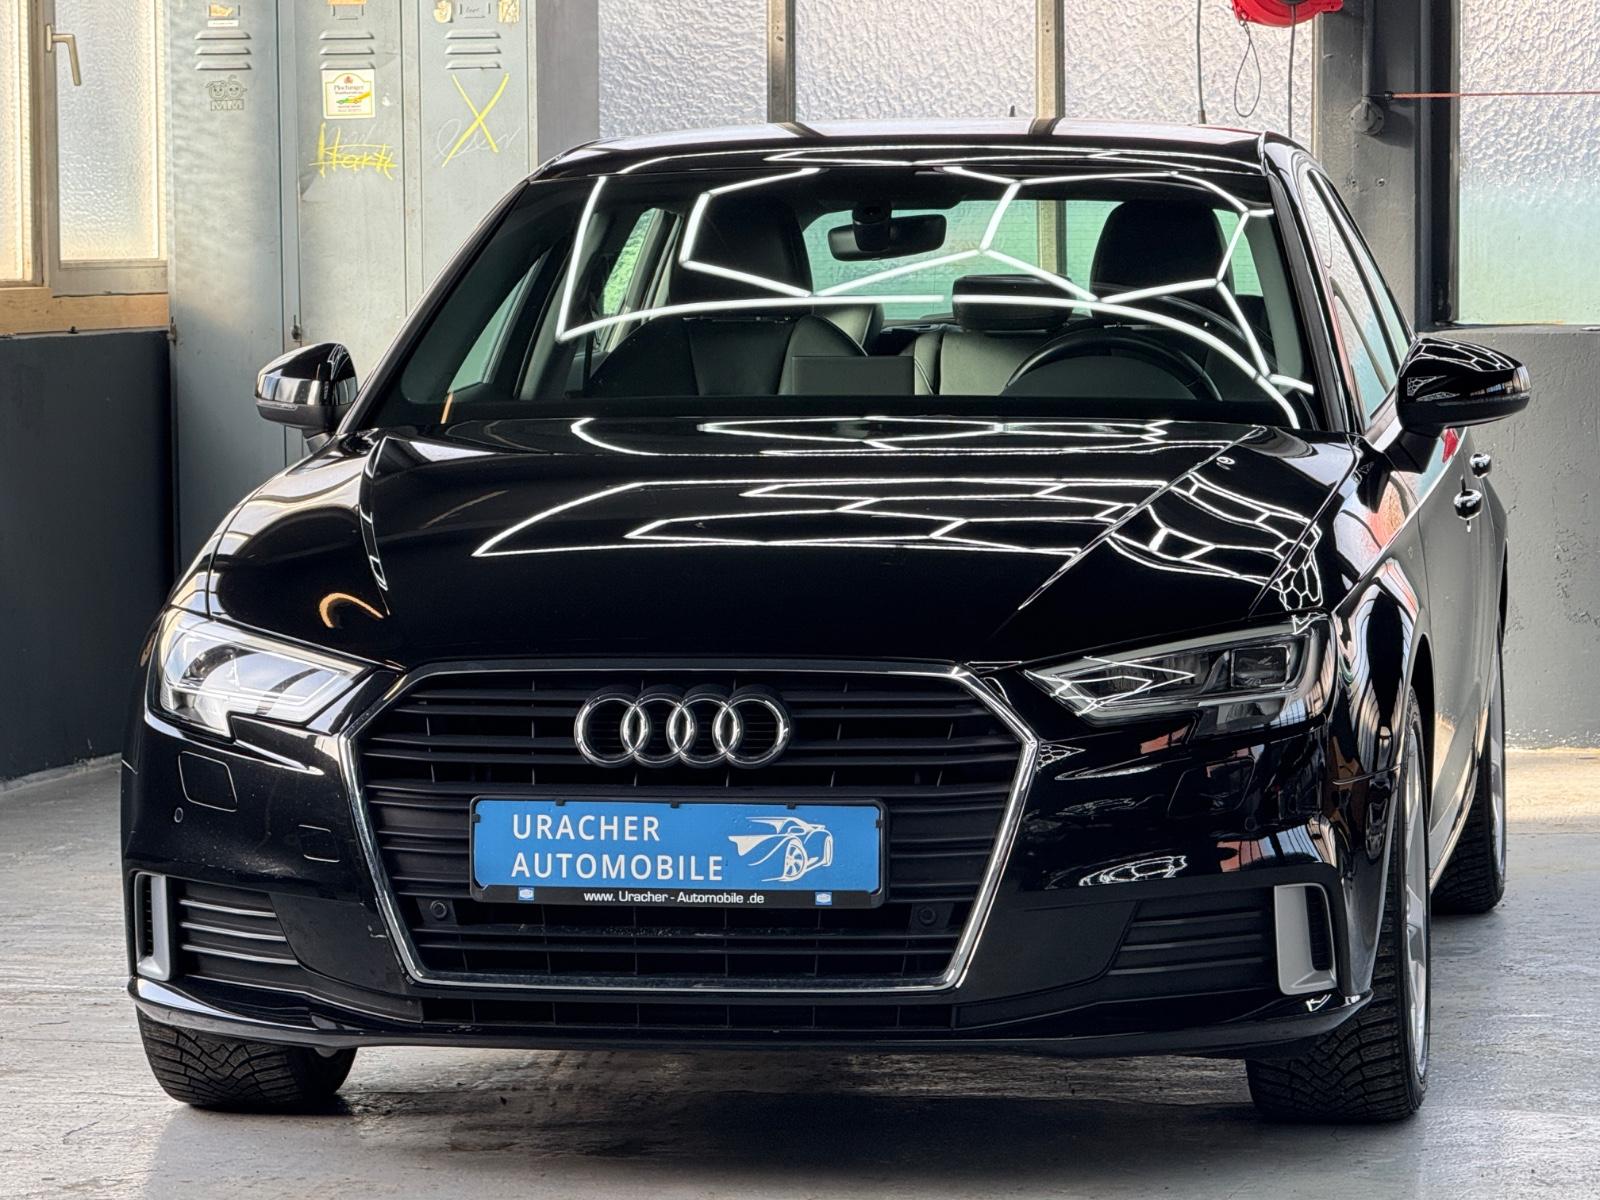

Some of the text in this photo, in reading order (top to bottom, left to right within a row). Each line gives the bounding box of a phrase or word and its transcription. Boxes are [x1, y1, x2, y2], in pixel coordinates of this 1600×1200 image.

[512, 813, 661, 842] URACHER
[511, 852, 724, 882] AUTOMOBILE
[618, 890, 669, 903] Uracher
[677, 892, 744, 905] Automobile
